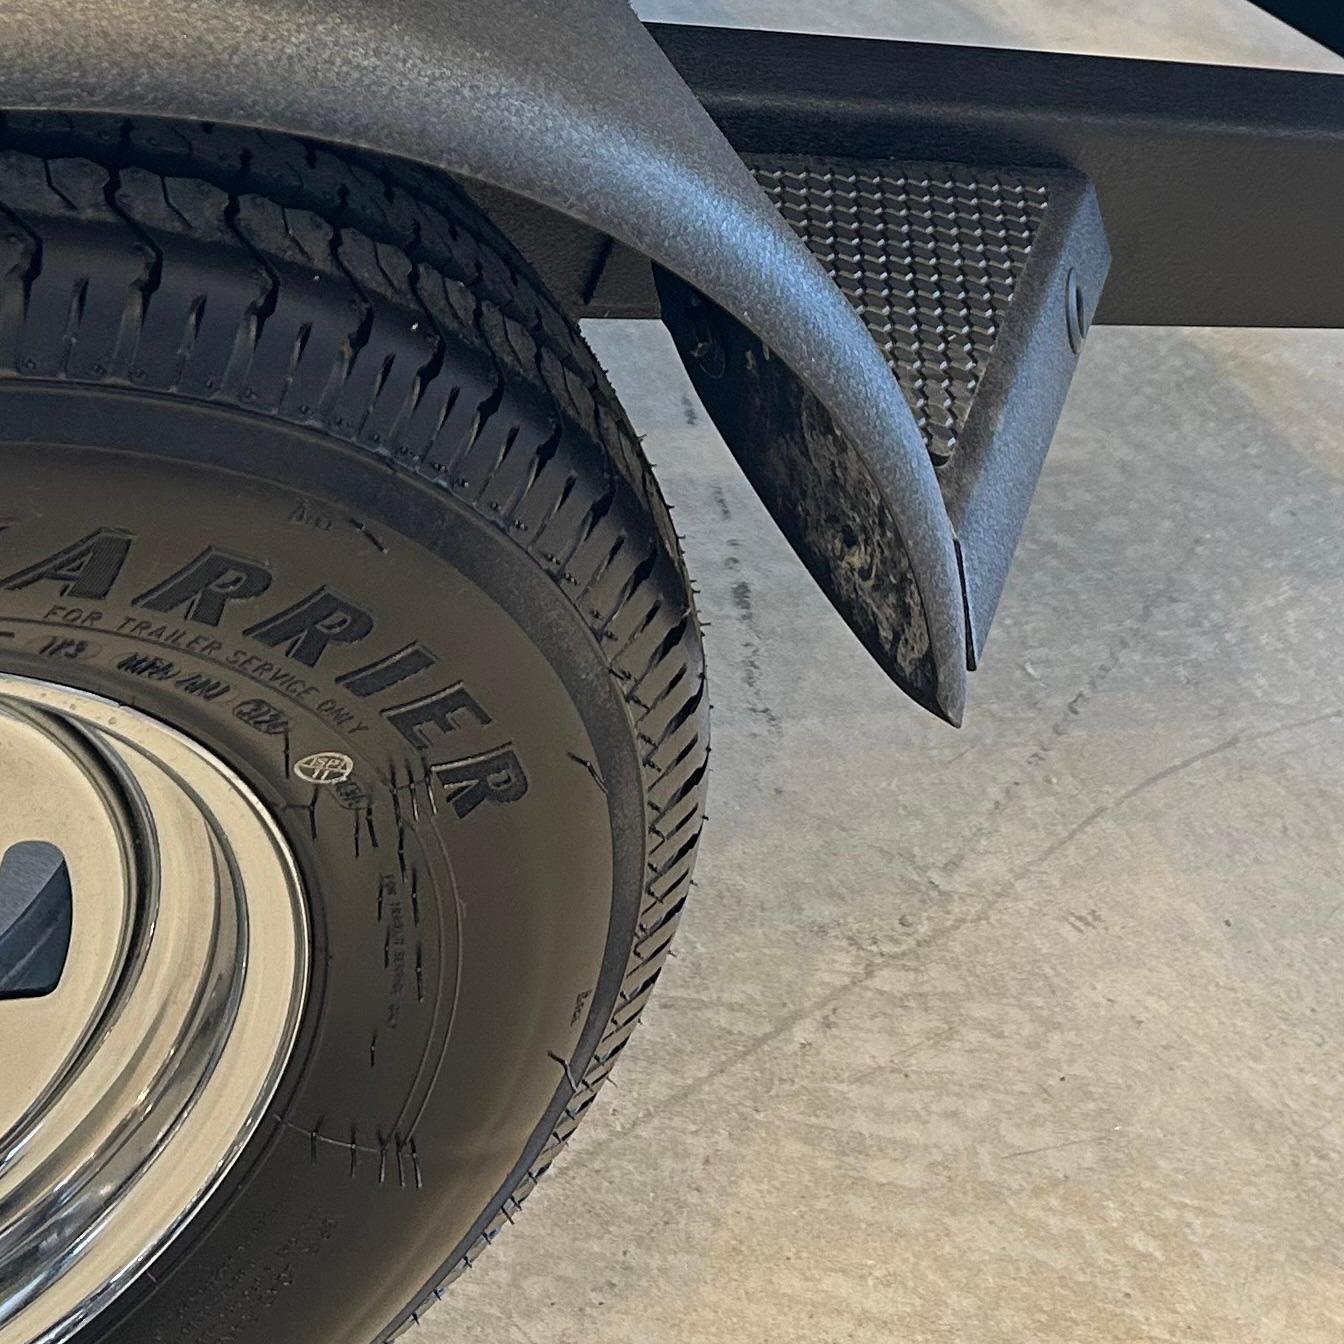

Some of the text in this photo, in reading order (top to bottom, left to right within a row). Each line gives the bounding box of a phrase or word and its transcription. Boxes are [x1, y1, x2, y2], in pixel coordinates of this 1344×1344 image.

[44, 605, 103, 628] FOR
[116, 615, 223, 656] TRAILER
[225, 648, 321, 701] SERVICE
[317, 698, 369, 736] ONLY
